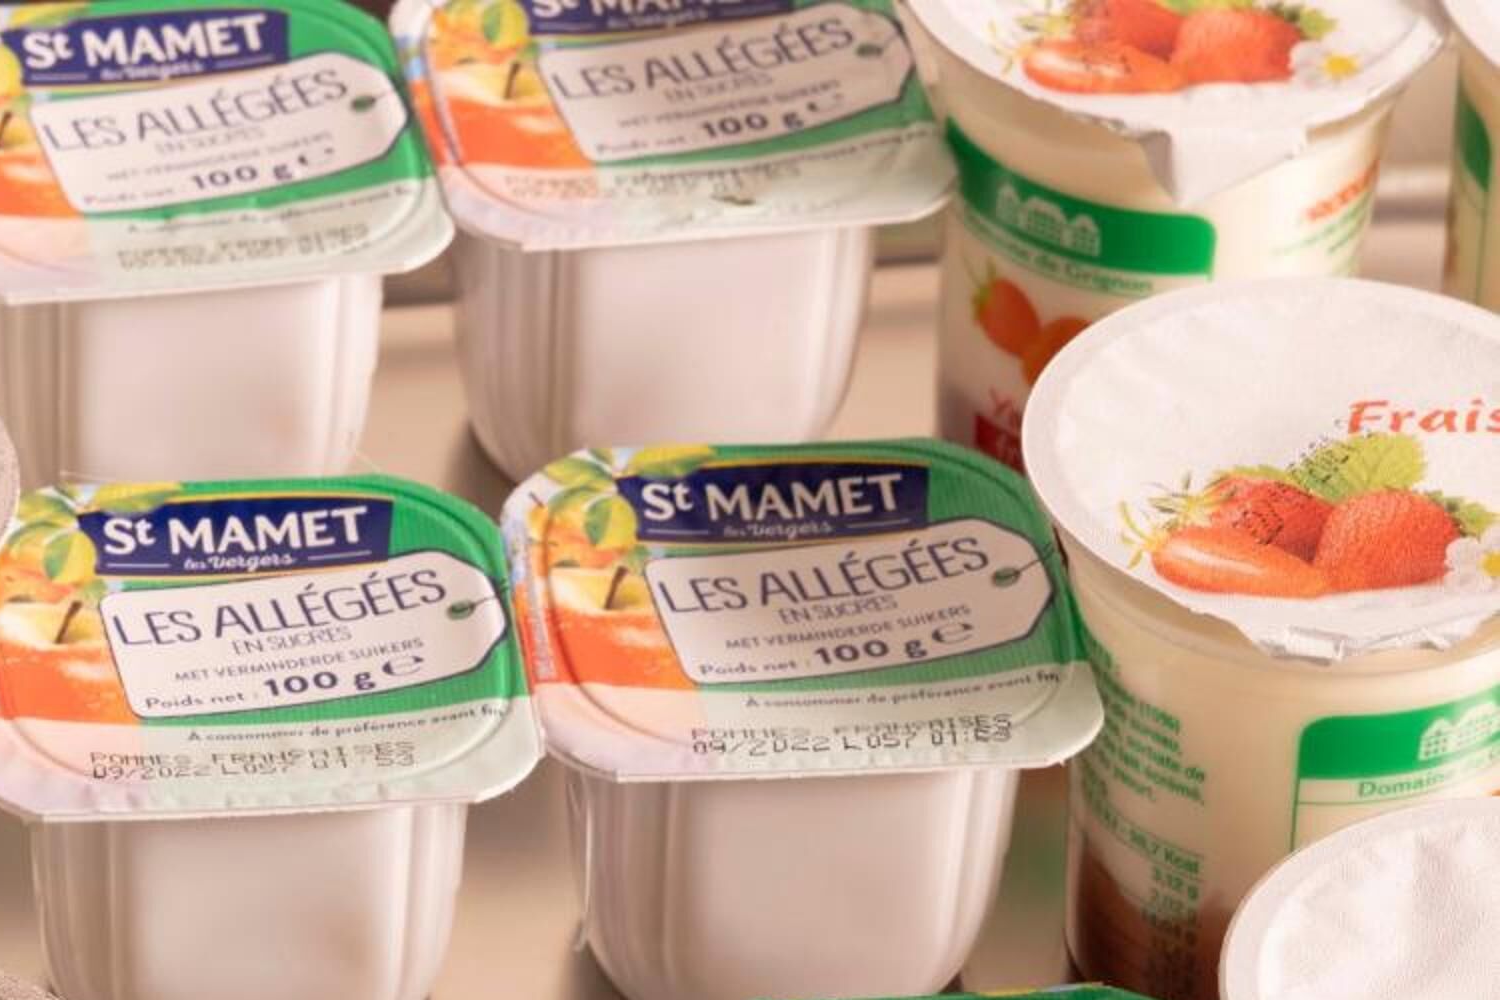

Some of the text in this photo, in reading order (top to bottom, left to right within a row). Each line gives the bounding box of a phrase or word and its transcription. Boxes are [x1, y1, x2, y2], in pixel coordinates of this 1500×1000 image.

[22, 13, 266, 69] St MAMET
[553, 64, 636, 100] LES
[645, 18, 853, 88] ALLÉGÉES
[44, 112, 124, 154] LES
[137, 68, 348, 142] ALLÉGÉES
[702, 113, 769, 138] 100
[192, 165, 258, 189] 100
[642, 473, 902, 522] St MAMET
[102, 506, 367, 554] St MAMET
[658, 537, 989, 614] LES ALLÉGÉES
[113, 569, 446, 646] LES ALLÉGÉES
[726, 605, 971, 650] MET VERMINDERDE SUIKERS
[778, 595, 899, 626] EN SUCRES
[175, 637, 425, 683] MET VERMINDERDE SUIKERS
[232, 626, 353, 656] EN SUCRES
[699, 639, 927, 675] Poids net 100 g
[145, 670, 376, 710] Poids net 100 g
[1358, 770, 1448, 798] Domain
